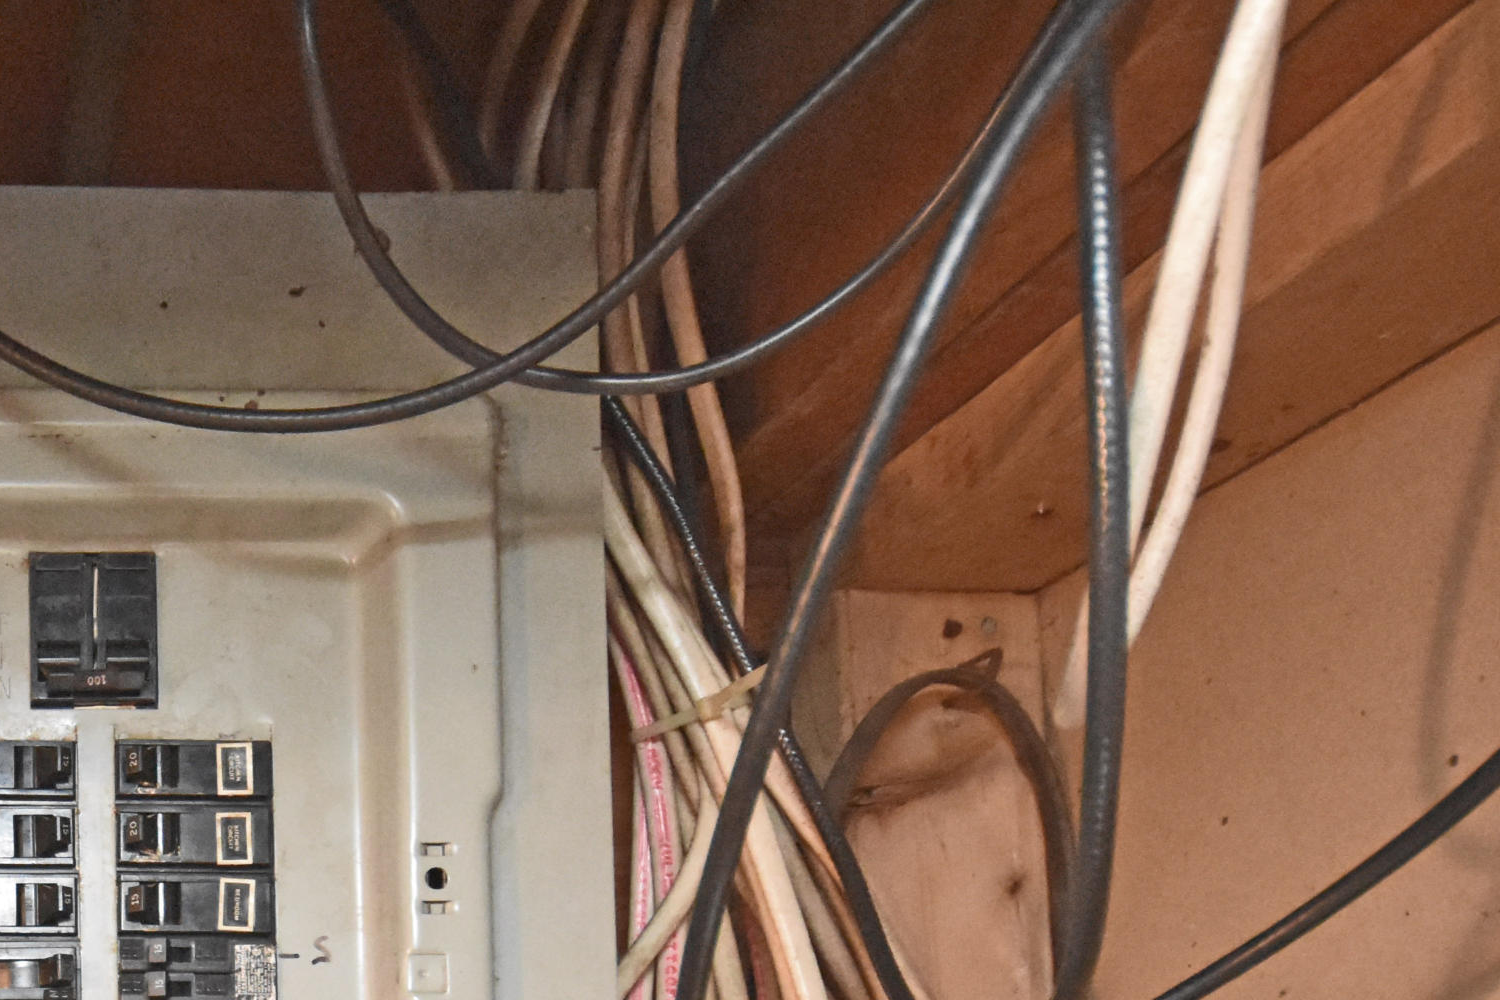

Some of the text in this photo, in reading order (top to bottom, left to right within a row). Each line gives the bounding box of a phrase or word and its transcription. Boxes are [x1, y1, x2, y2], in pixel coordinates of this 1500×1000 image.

[87, 675, 107, 685] 100
[129, 753, 137, 767] 20
[129, 821, 137, 836] 20
[131, 894, 139, 906] 15
[153, 943, 163, 954] 15
[154, 979, 164, 988] 15
